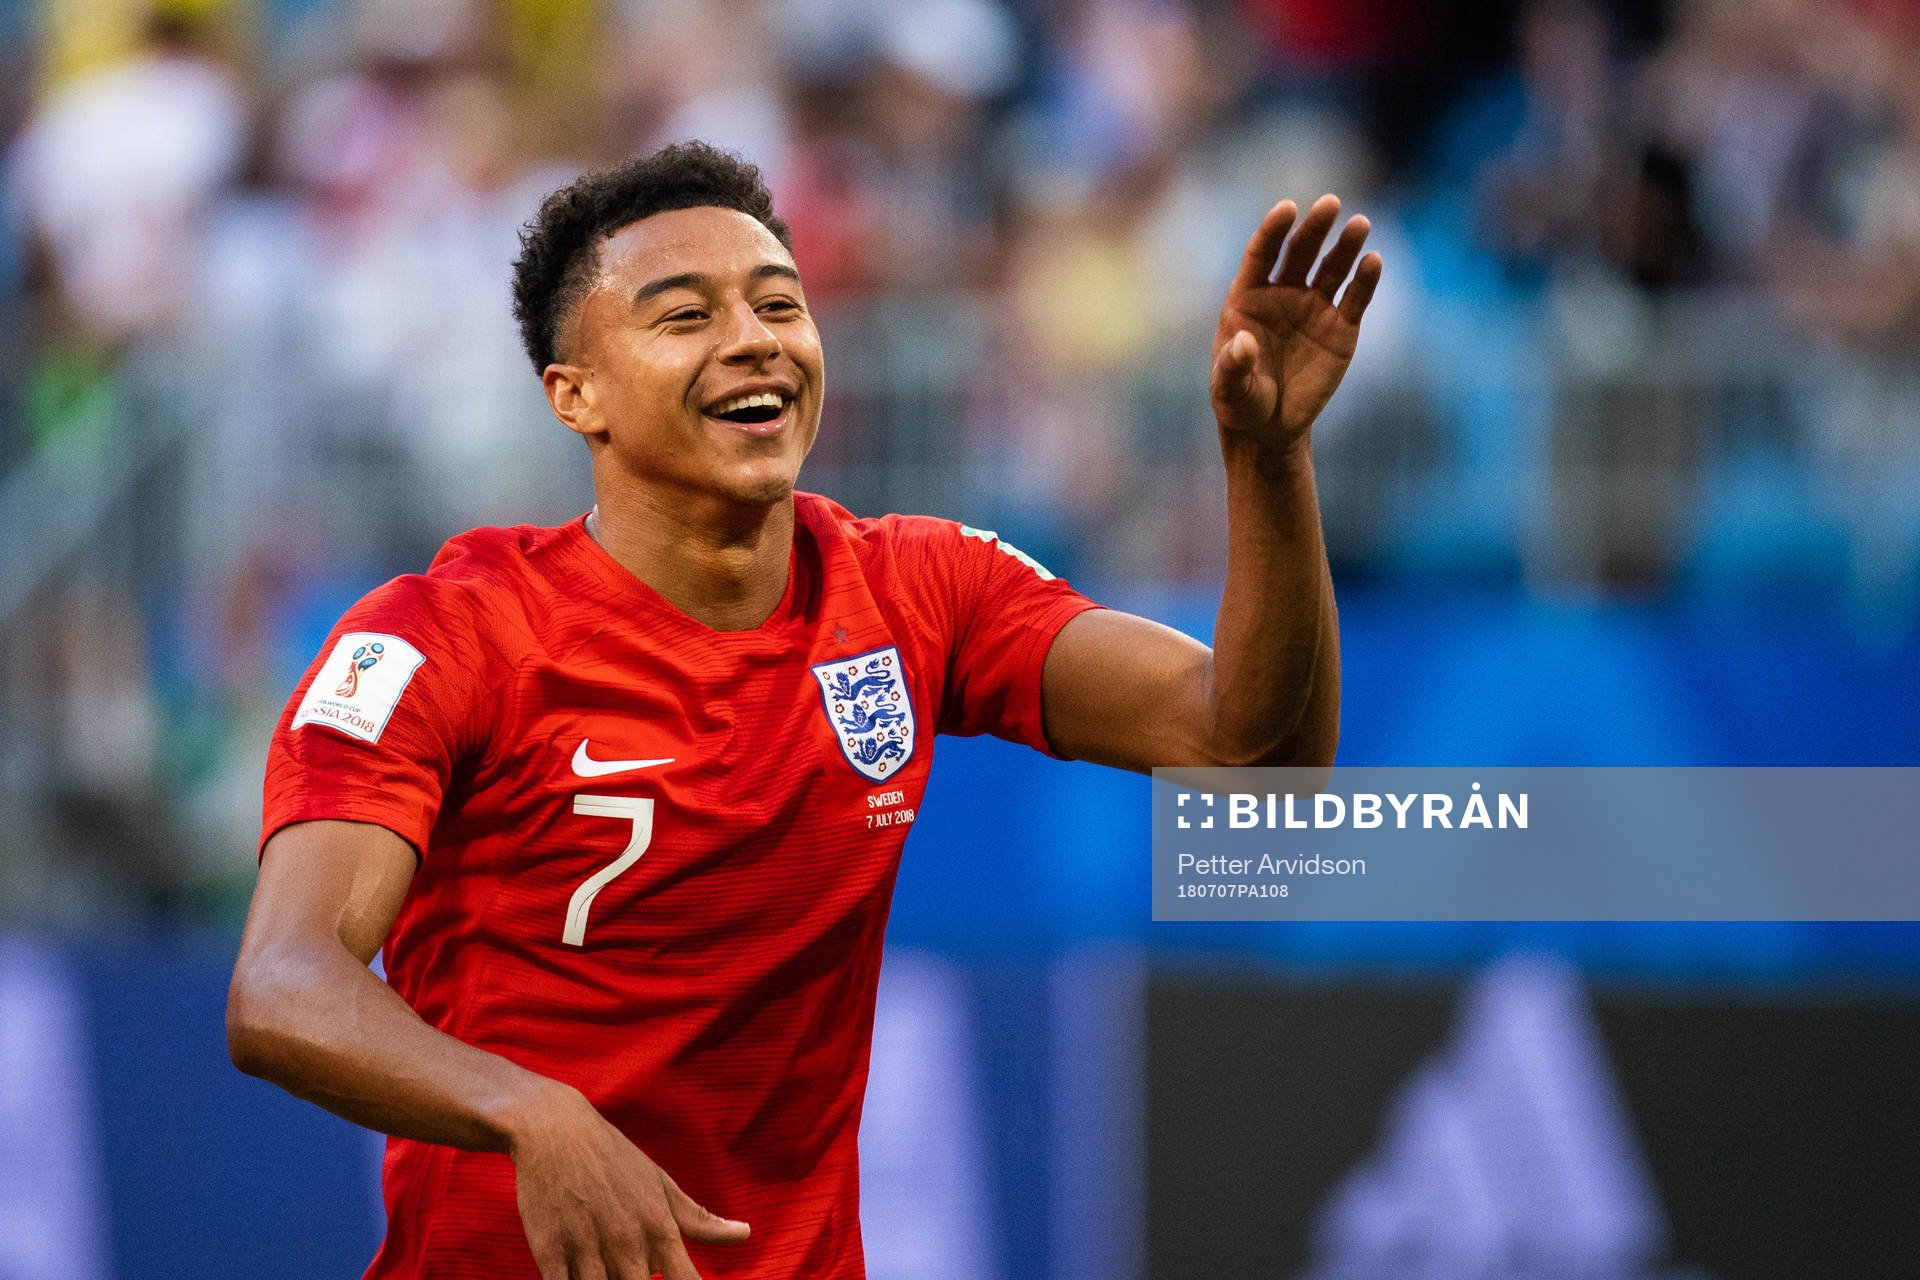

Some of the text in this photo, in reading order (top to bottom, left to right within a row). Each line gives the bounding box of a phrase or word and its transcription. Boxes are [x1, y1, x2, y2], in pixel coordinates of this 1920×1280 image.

[349, 704, 361, 713] CUP
[301, 706, 375, 733] SSIA 2018
[867, 790, 905, 809] SWEDEN
[866, 808, 915, 829] 7 JULY 2018
[562, 794, 655, 947] 7
